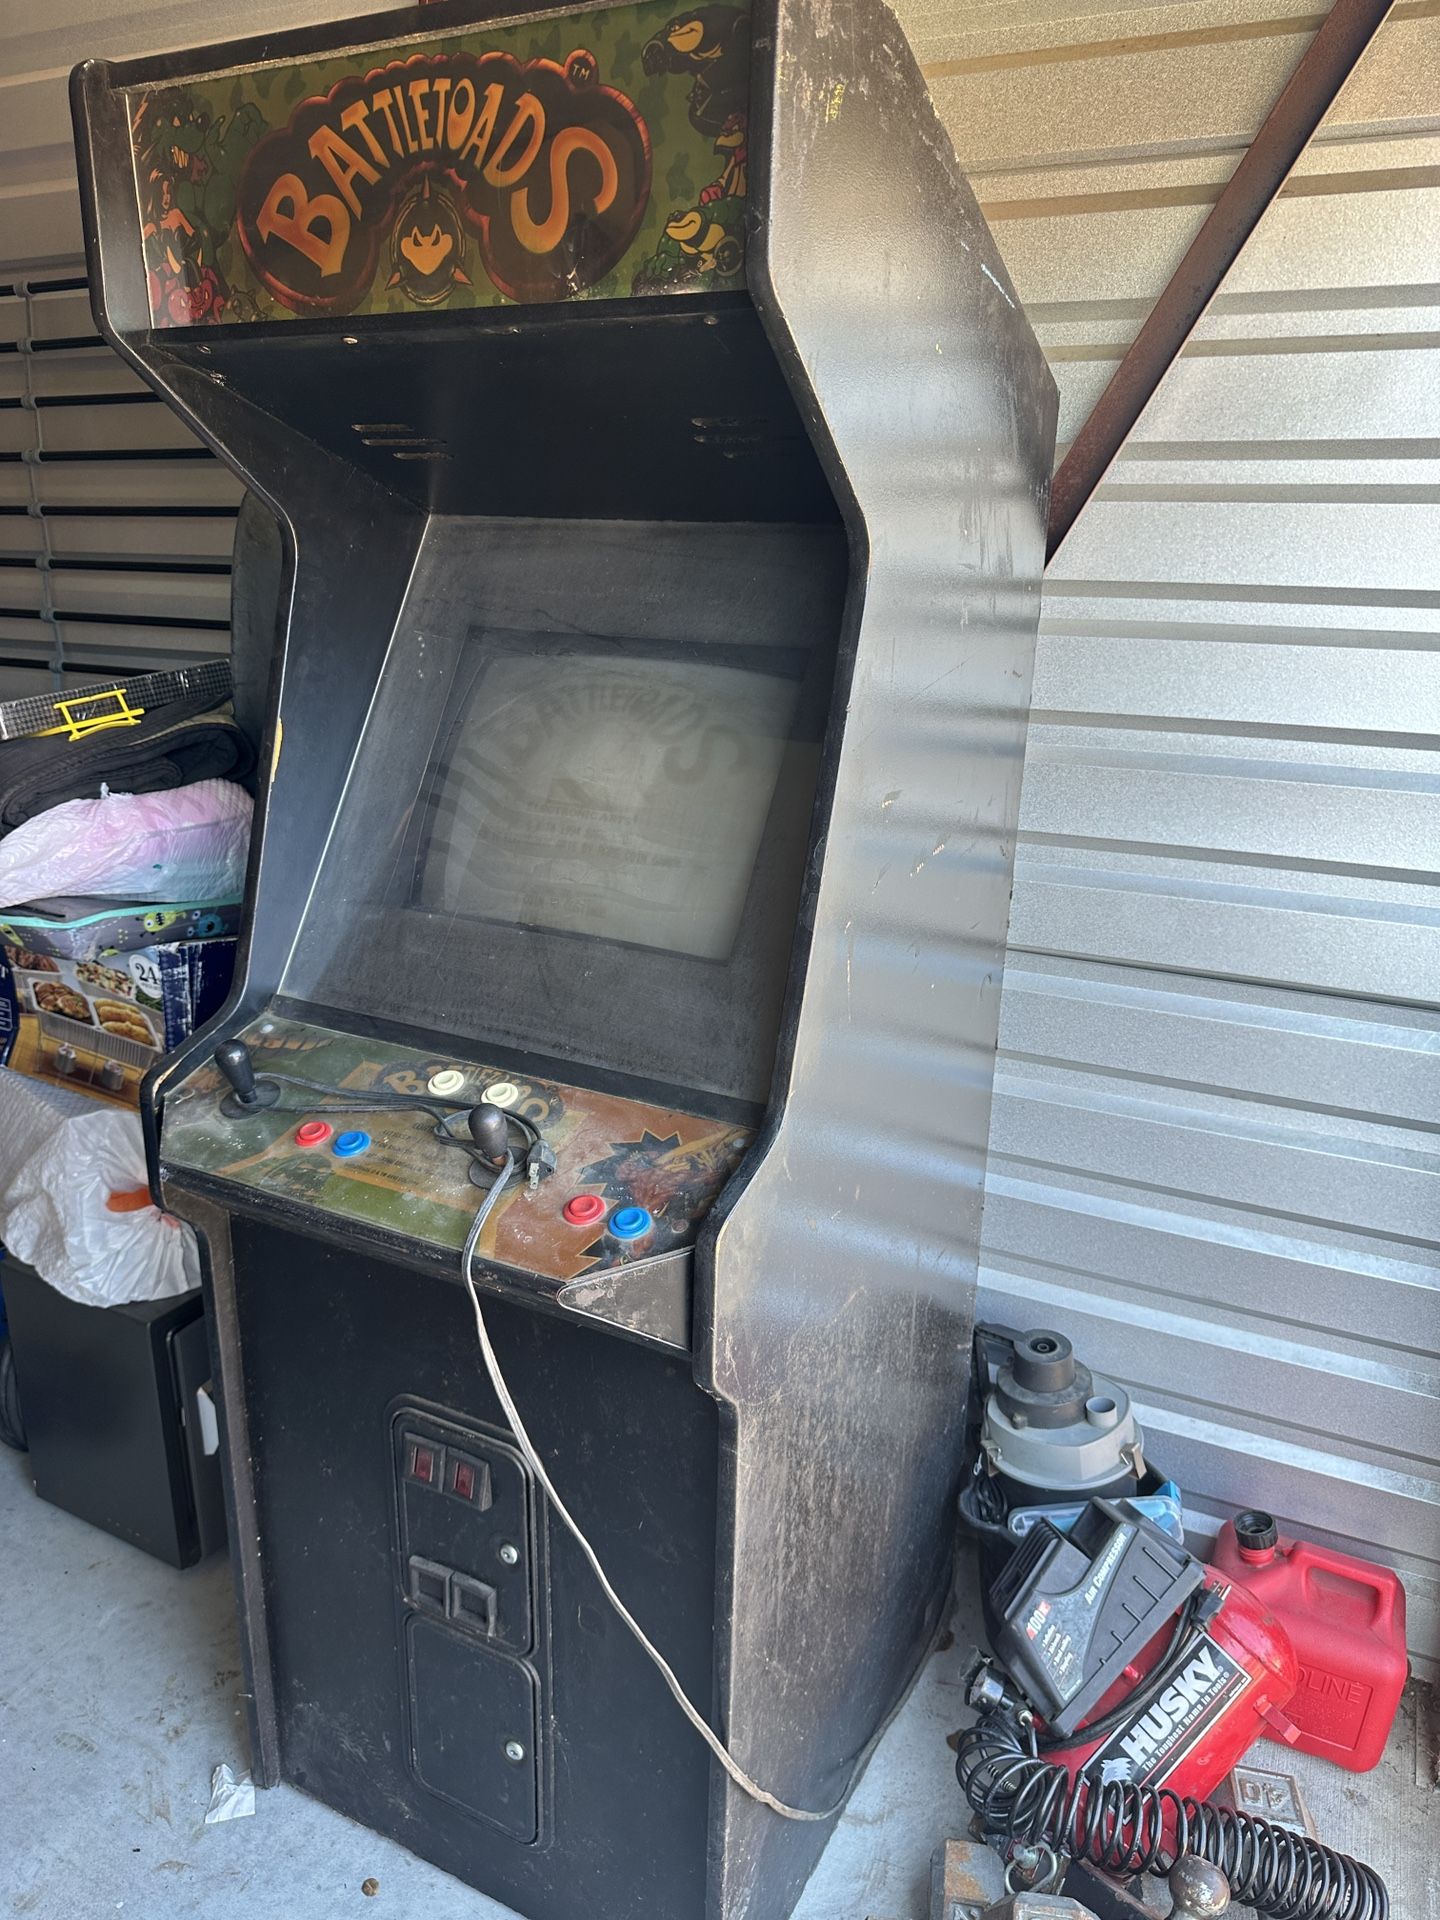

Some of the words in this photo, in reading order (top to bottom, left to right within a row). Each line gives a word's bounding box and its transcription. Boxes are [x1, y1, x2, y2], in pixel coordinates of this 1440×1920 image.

[256, 77, 619, 279] BATTLETOADS
[571, 63, 591, 81] TM
[1084, 1585, 1098, 1606] AIR
[1093, 1532, 1127, 1588] COMPRESSOR
[1141, 1756, 1157, 1772] The
[1154, 1724, 1185, 1758] Toughest
[1183, 1703, 1204, 1727] Name
